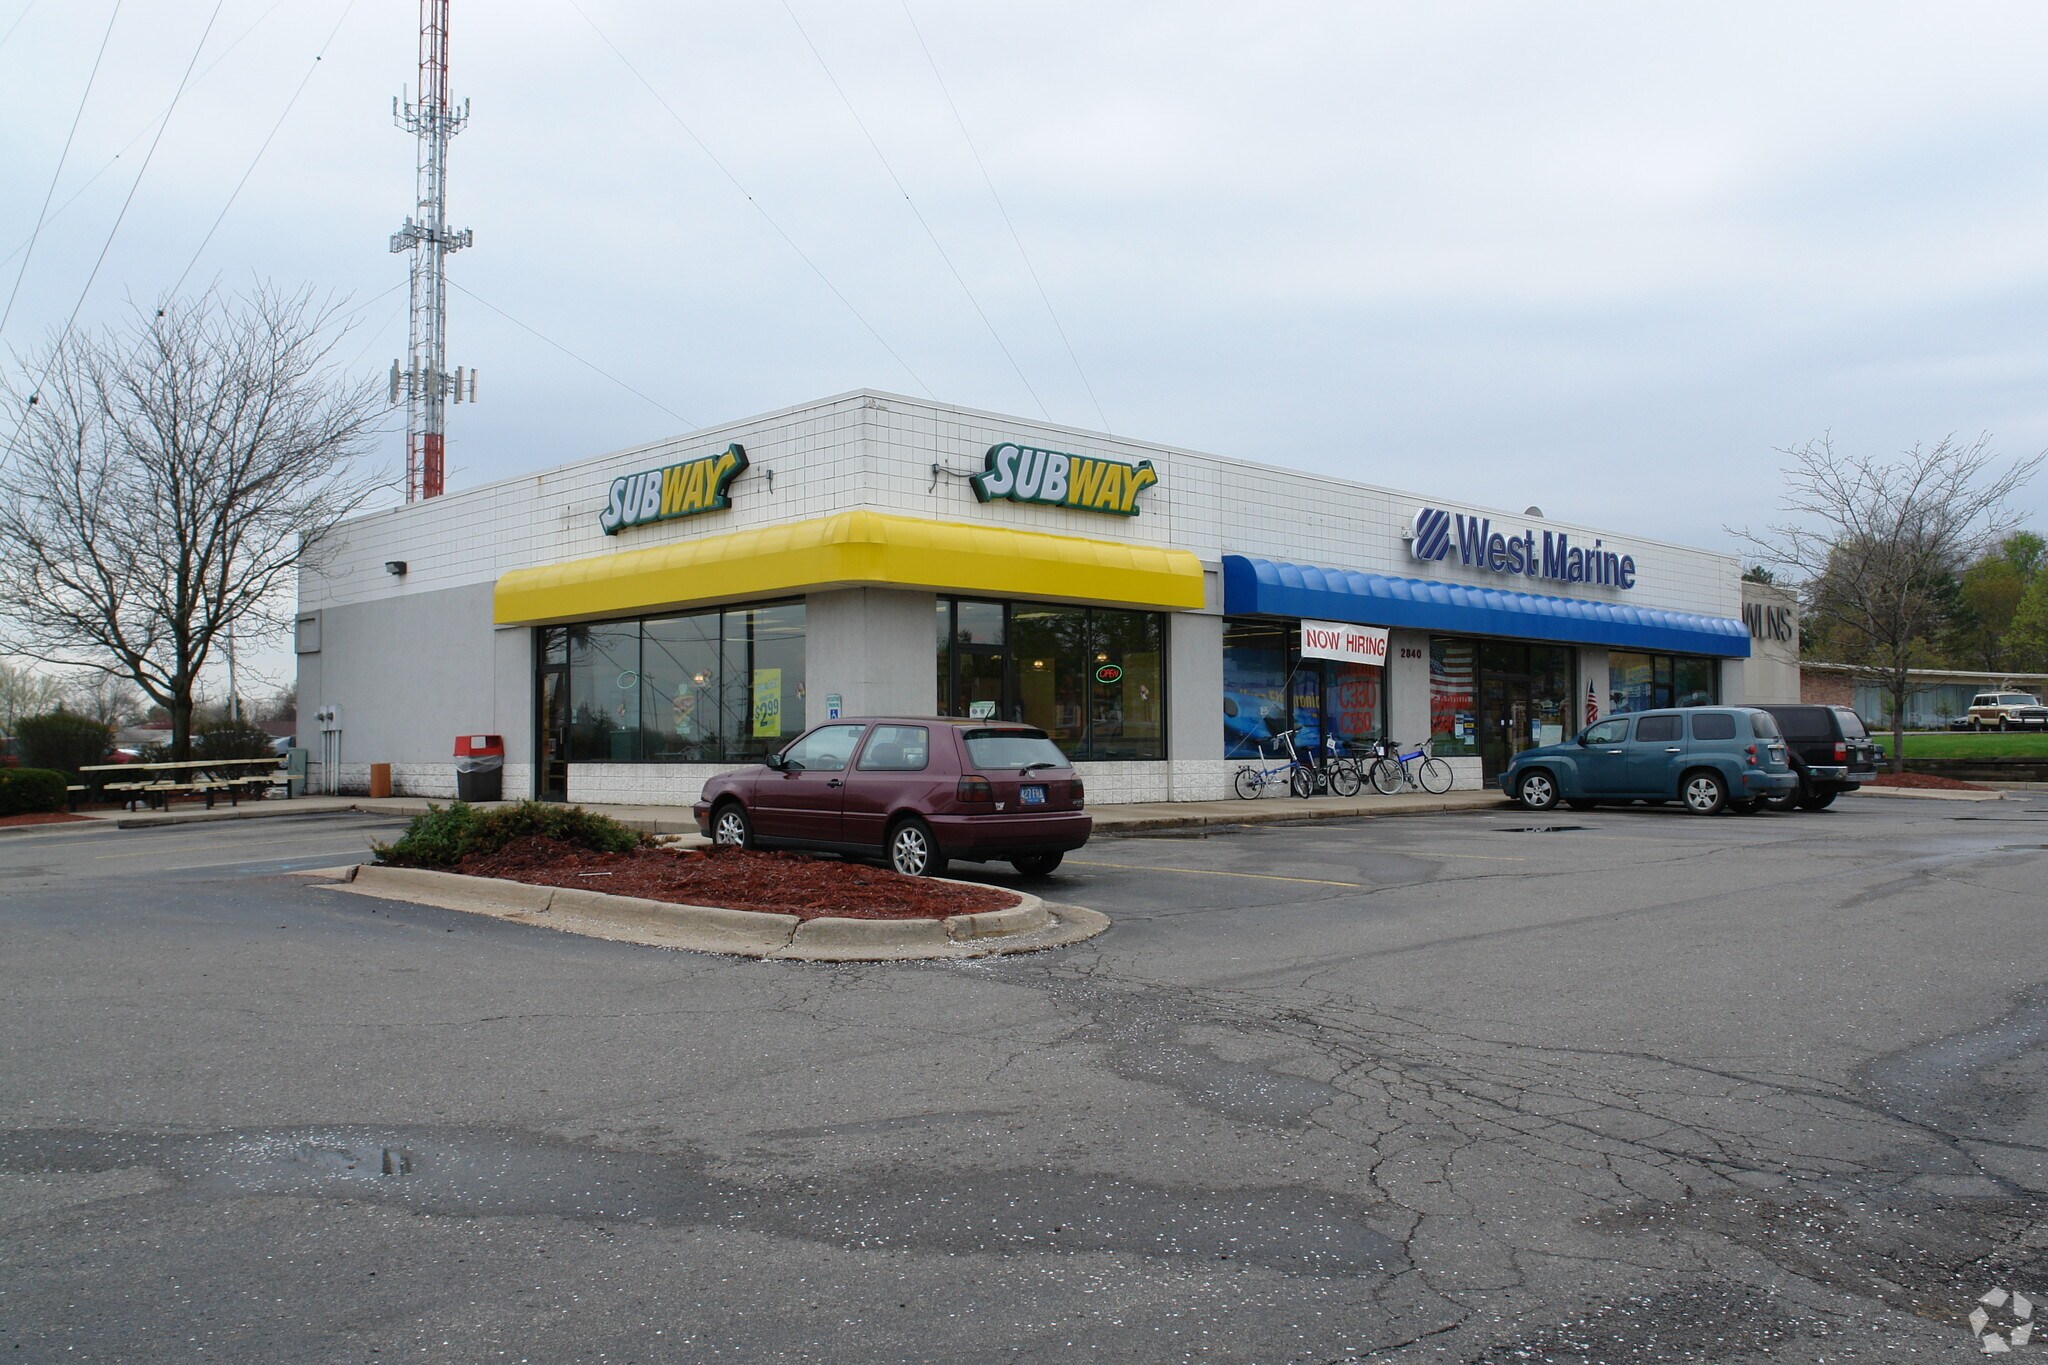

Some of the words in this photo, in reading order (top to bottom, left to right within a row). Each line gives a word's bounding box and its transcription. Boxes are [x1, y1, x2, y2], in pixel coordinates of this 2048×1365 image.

[600, 450, 737, 530] SUBWAY
[982, 445, 1157, 512] SUBWAY
[1455, 513, 1536, 576] West
[1542, 530, 1636, 590] Marine
[1306, 629, 1340, 650] NOW
[1346, 634, 1385, 656] HIRING
[1401, 649, 1421, 659] 2840
[1099, 669, 1119, 679] OPEN
